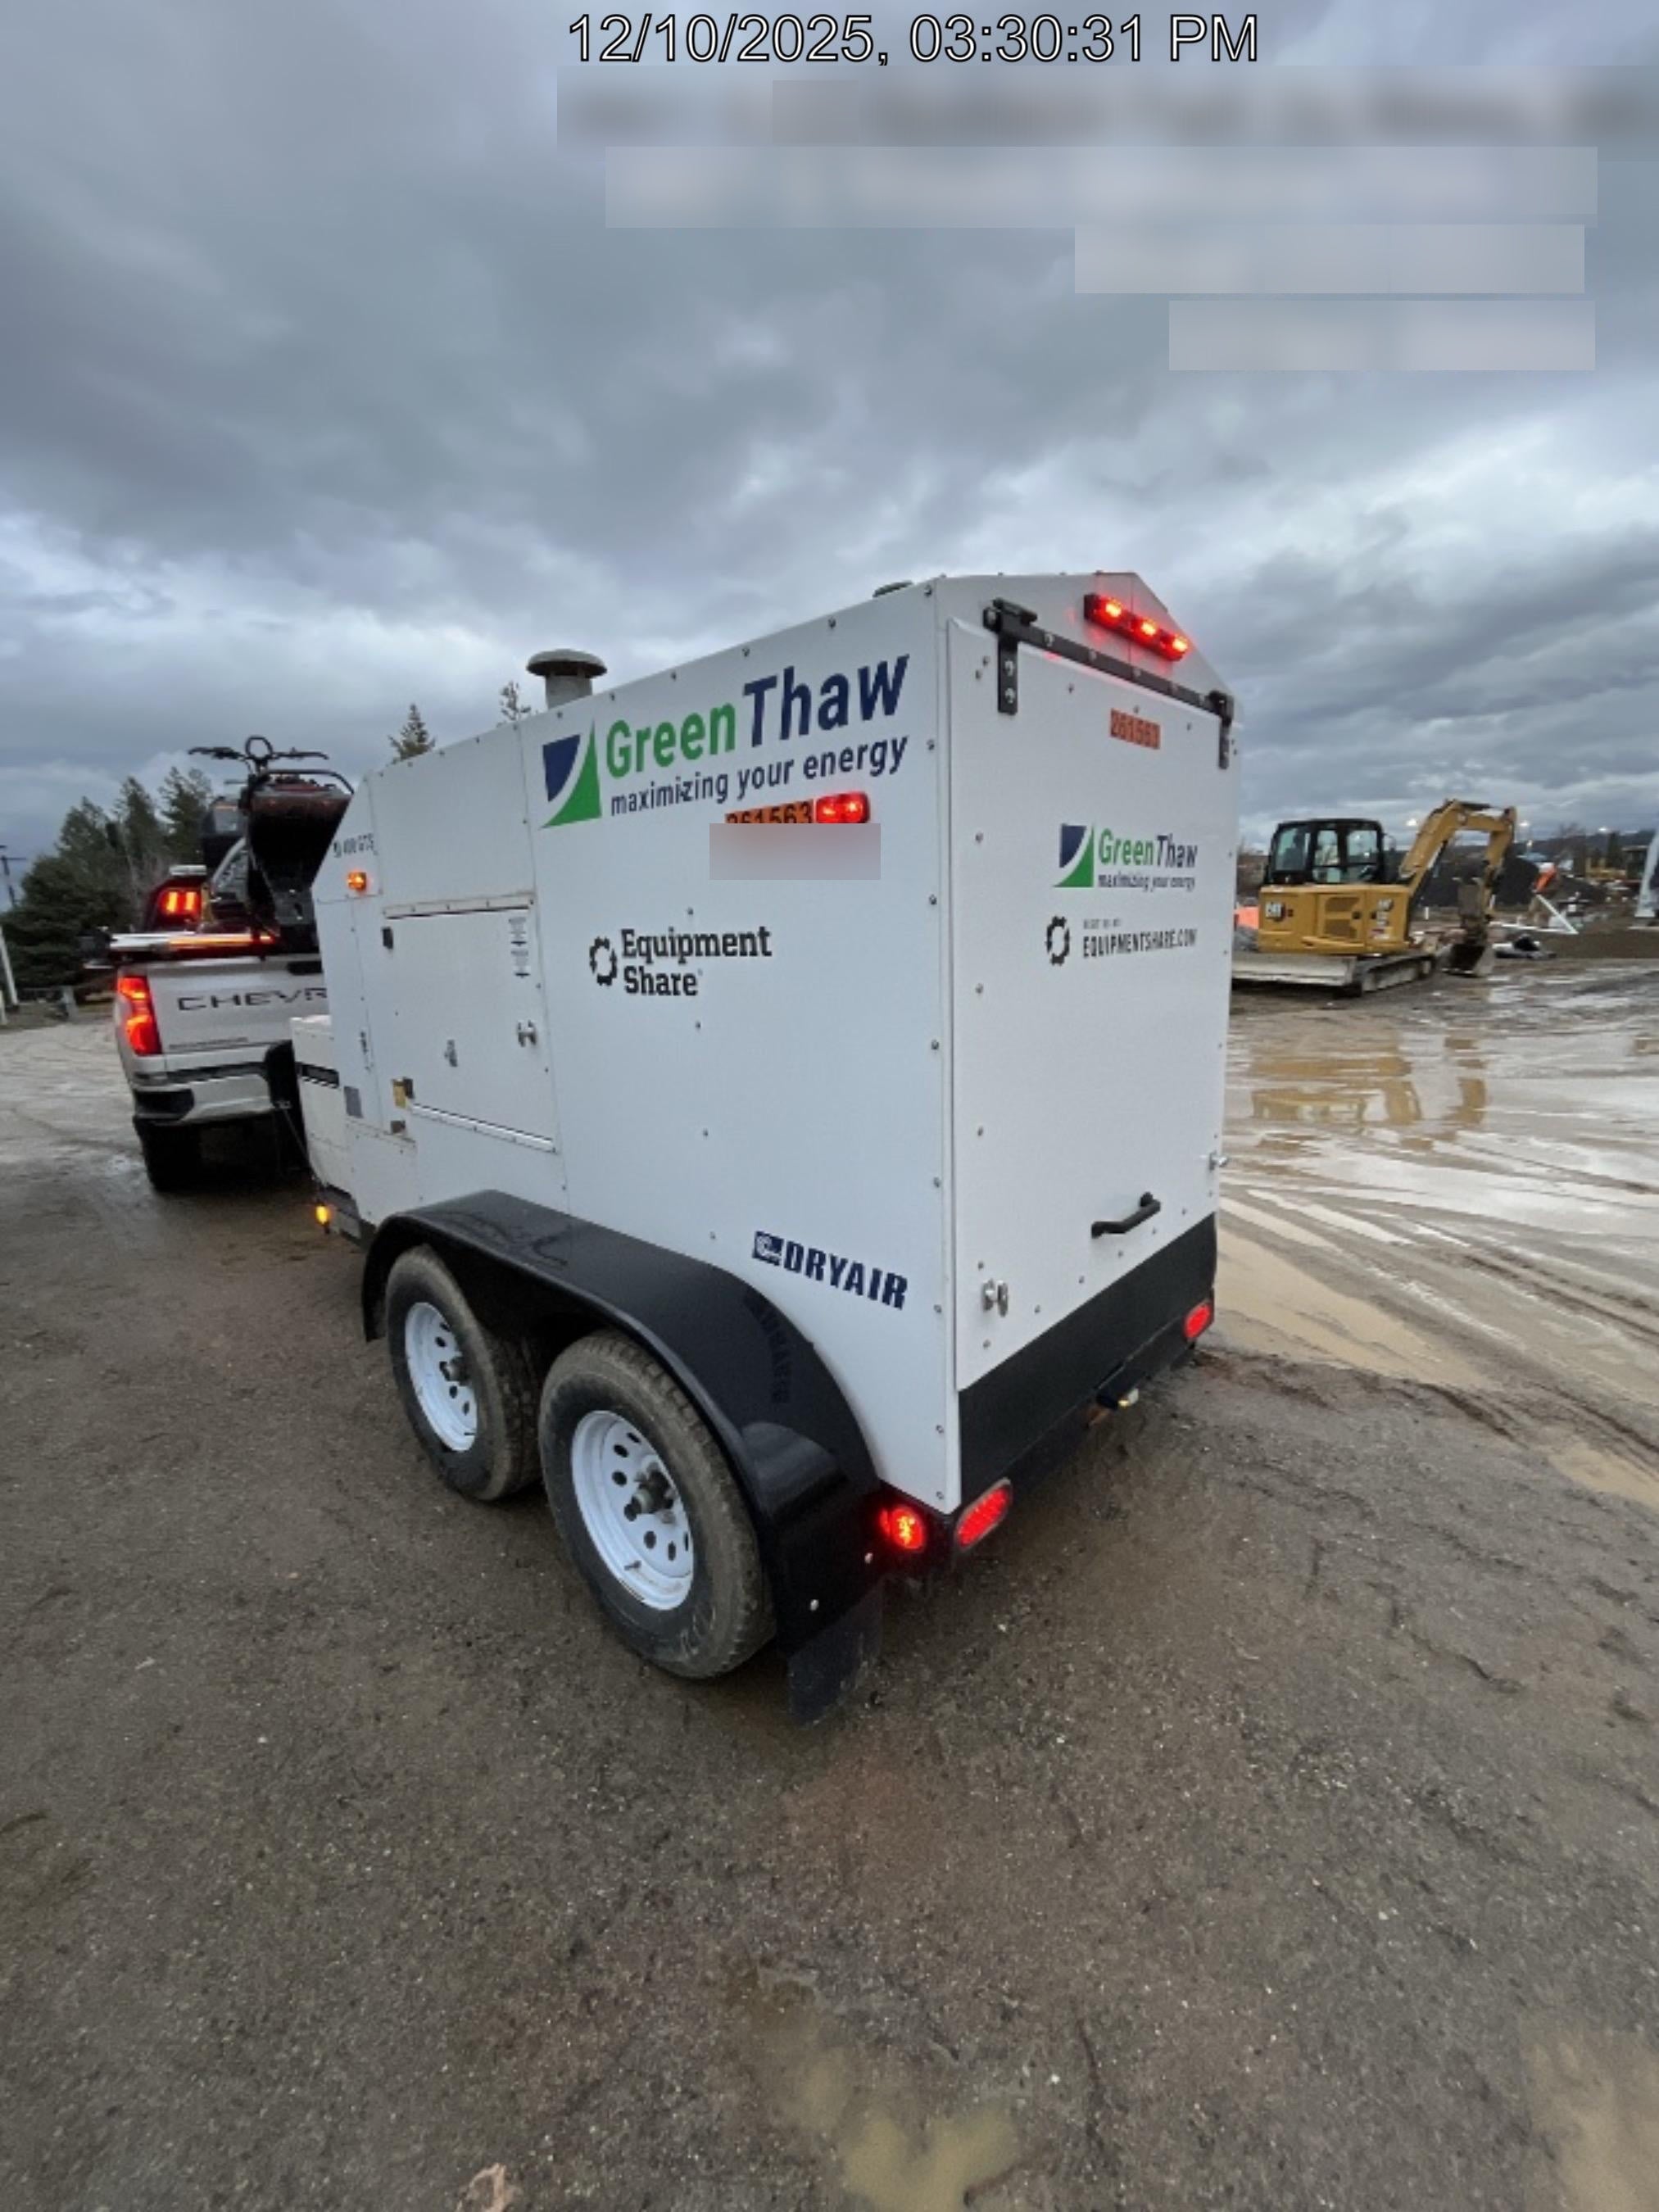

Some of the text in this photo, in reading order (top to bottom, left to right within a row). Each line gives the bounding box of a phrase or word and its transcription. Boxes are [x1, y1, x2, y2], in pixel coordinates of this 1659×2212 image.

[611, 735, 910, 817] maximizing your energy
[620, 925, 773, 965] Equipment
[623, 965, 699, 996] Share
[783, 1240, 909, 1311] DRYAIR
